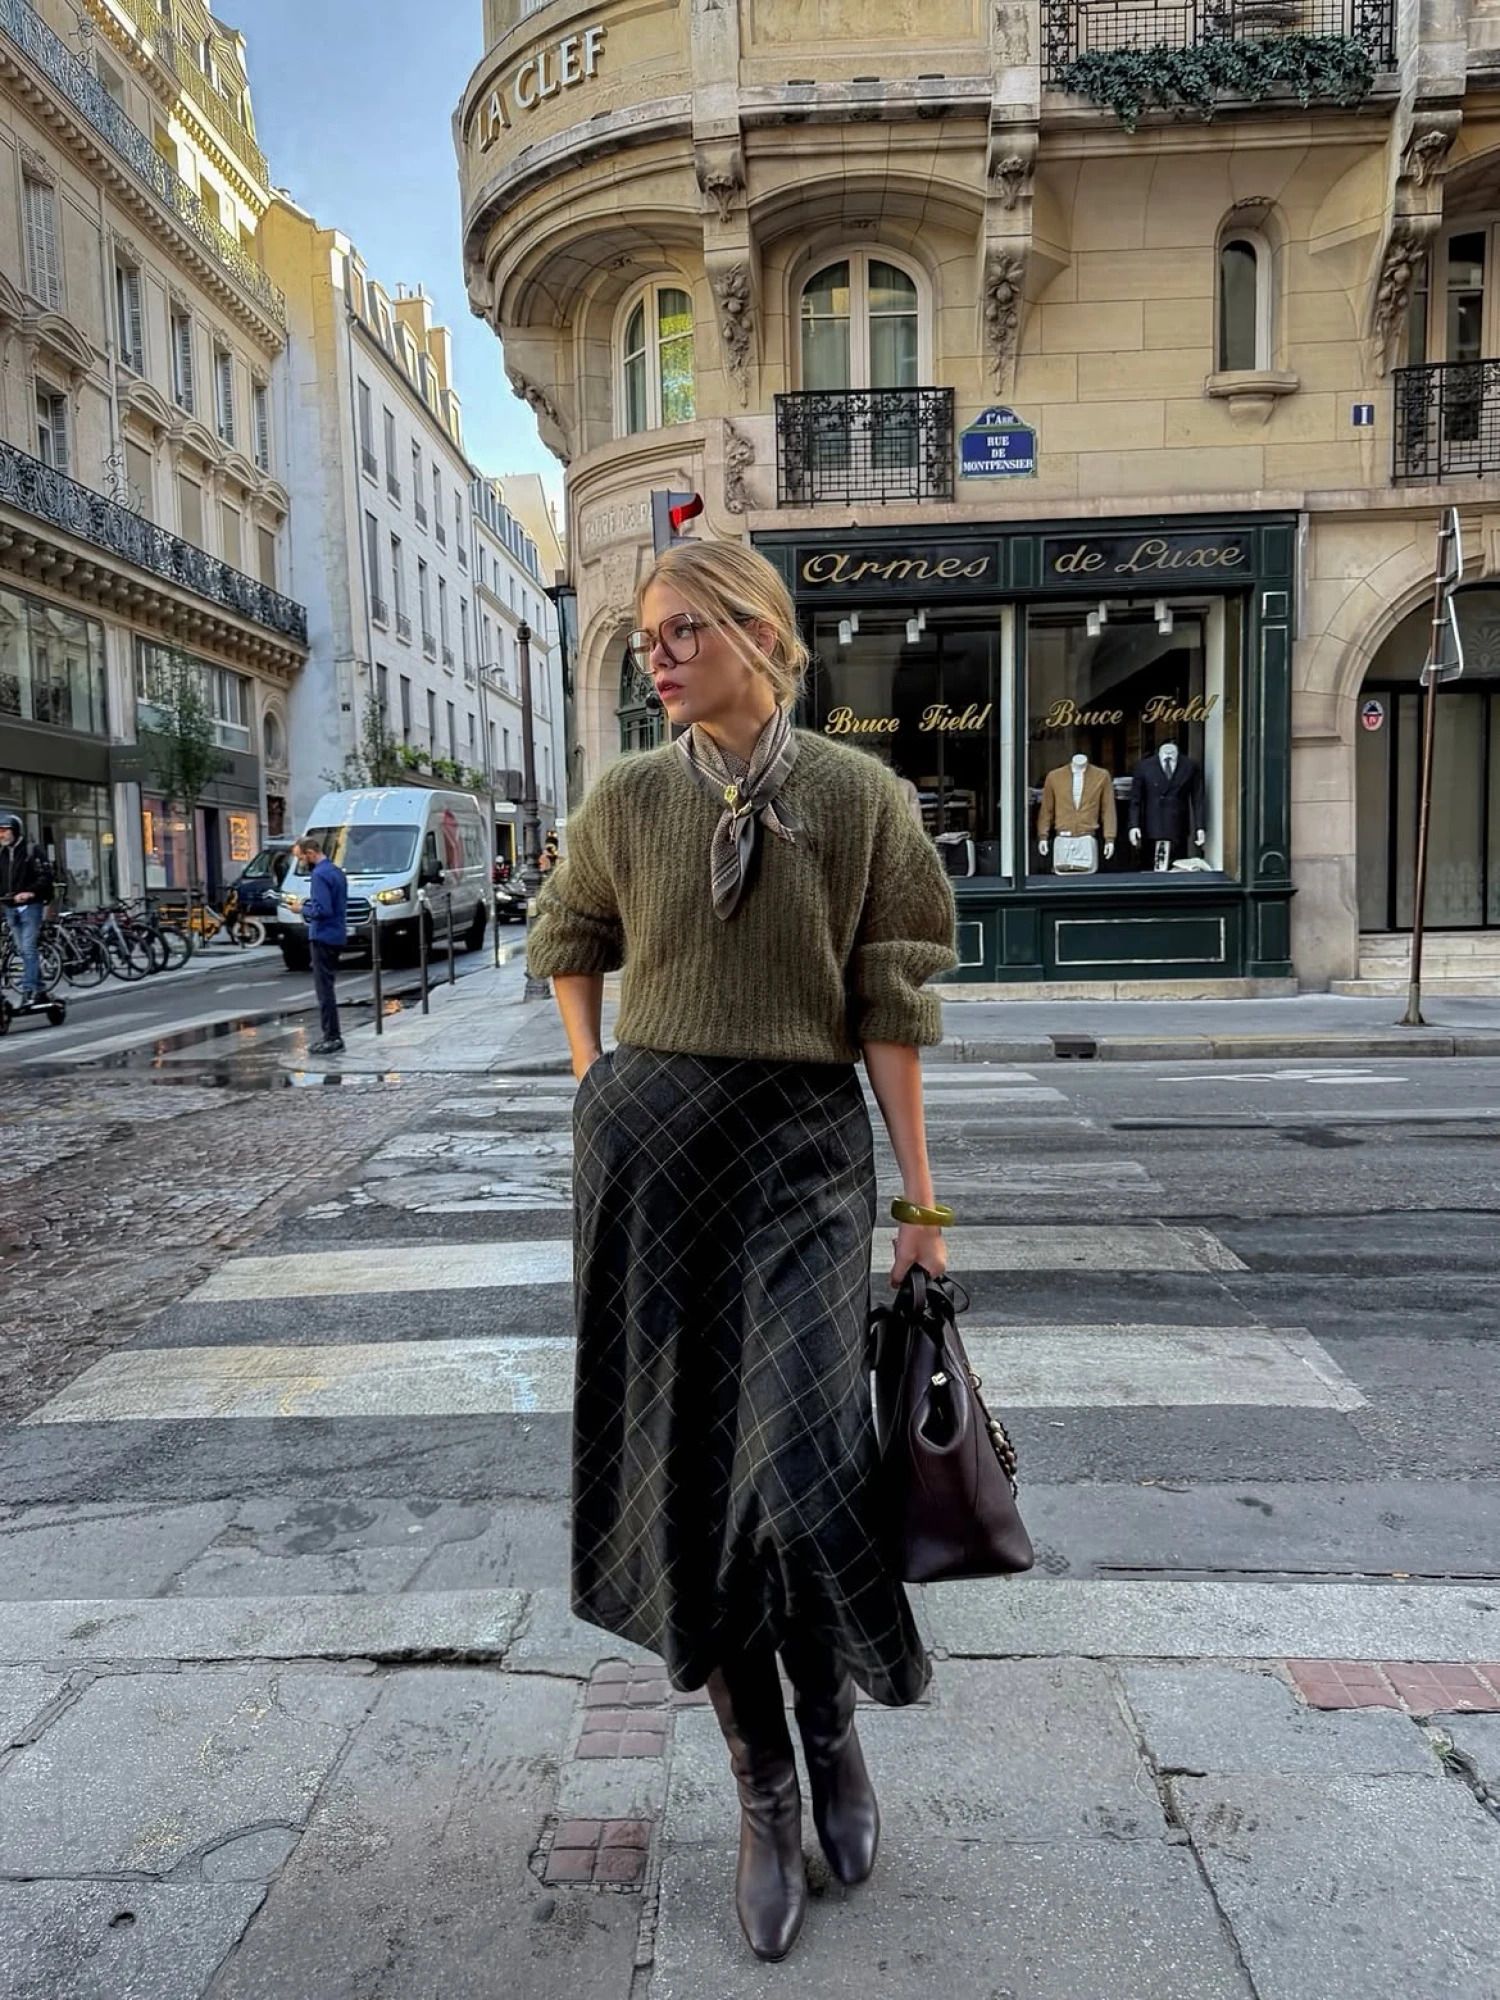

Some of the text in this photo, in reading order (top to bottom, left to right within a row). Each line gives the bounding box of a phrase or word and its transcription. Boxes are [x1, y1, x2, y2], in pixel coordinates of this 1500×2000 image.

[477, 25, 607, 153] LA CLEF
[987, 436, 1010, 447] RUE
[991, 449, 1006, 459] DE
[963, 458, 1033, 472] MONTPENSIER
[1054, 544, 1106, 573] de
[1113, 538, 1246, 574] Luxe
[824, 702, 993, 735] Bruce Field
[1045, 693, 1219, 729] Bruce Field
